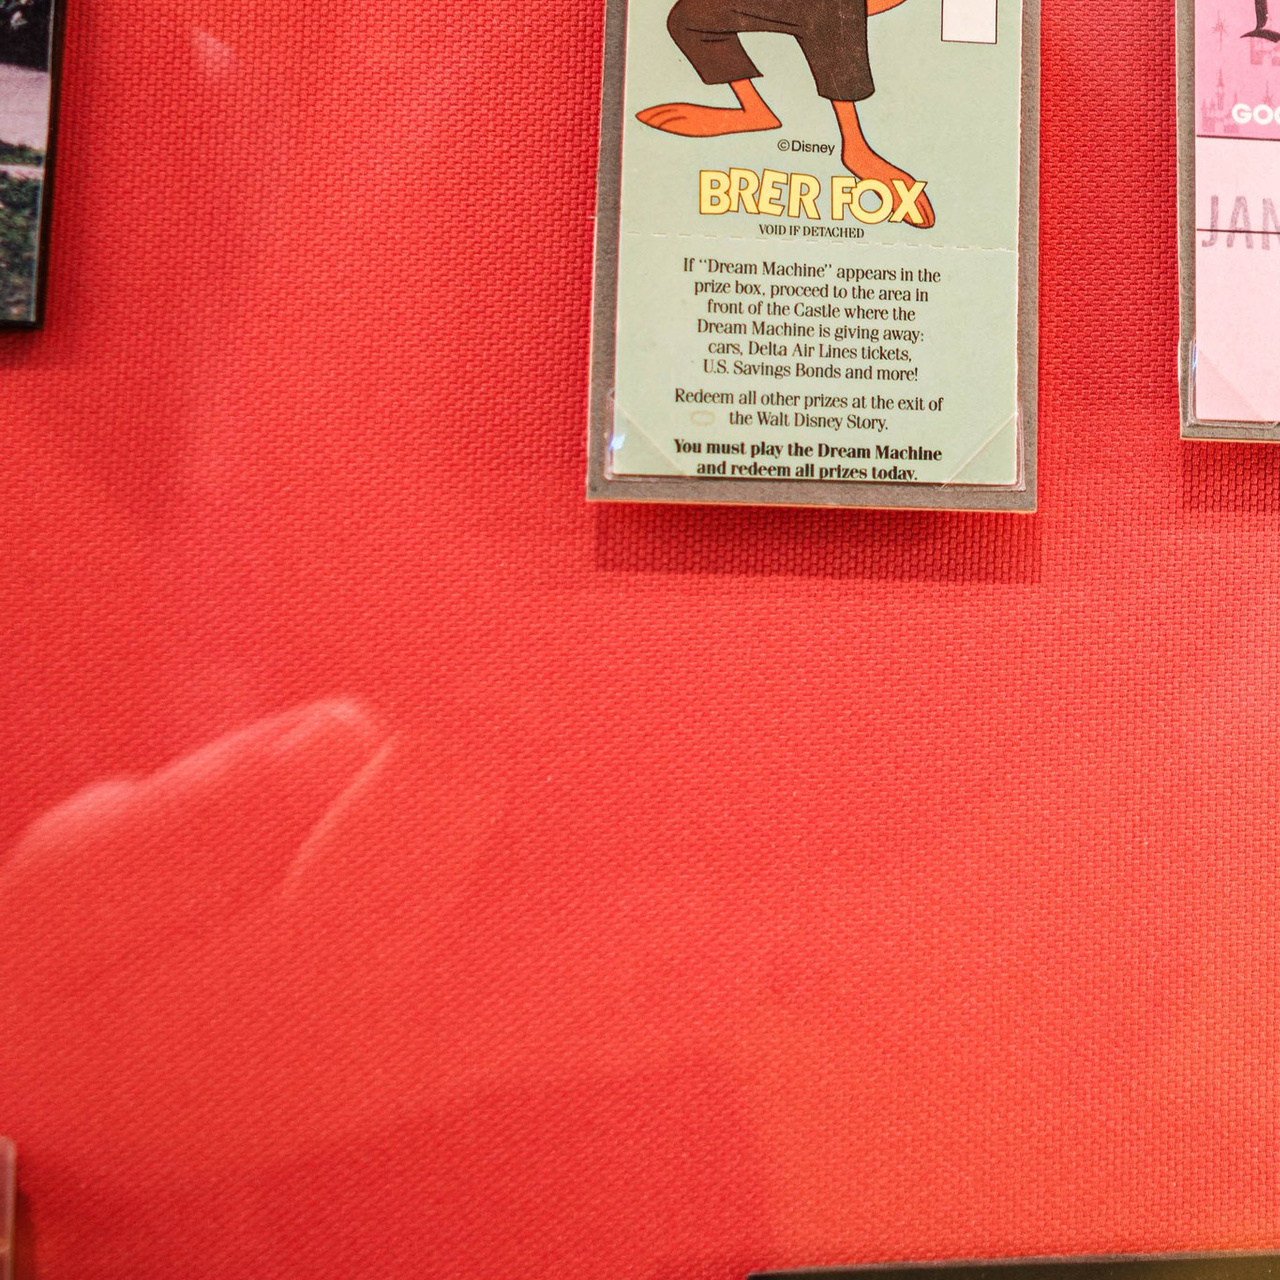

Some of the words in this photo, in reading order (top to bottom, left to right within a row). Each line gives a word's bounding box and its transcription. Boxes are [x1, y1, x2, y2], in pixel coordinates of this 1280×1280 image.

[699, 168, 821, 219] BRER
[831, 176, 928, 224] FOX
[759, 224, 786, 235] VOID
[790, 225, 800, 235] IF
[803, 226, 864, 238] DETACHED
[684, 258, 695, 271] If
[837, 265, 896, 282] appears
[901, 268, 913, 282] in
[918, 270, 941, 283] the
[694, 280, 730, 296] prize
[770, 283, 828, 298] proceed
[833, 286, 847, 299] to
[852, 285, 875, 300] the
[879, 289, 911, 301] area
[915, 288, 929, 302] in
[707, 299, 743, 314] front
[748, 301, 763, 315] of
[767, 302, 790, 316] the
[794, 303, 840, 319] Castle
[844, 306, 888, 320] where
[893, 307, 915, 321] the
[697, 319, 747, 335] Dream
[752, 321, 814, 338] Machine
[819, 324, 831, 338] is
[835, 325, 879, 342] giving
[883, 328, 924, 343] away:
[708, 342, 743, 356] cars,
[748, 341, 787, 356] Delta
[792, 343, 815, 357] Air
[819, 344, 857, 359] Lines
[861, 346, 912, 362] tickets,
[703, 359, 730, 374] U.S.
[734, 360, 791, 379] Savings
[796, 363, 841, 379] Bonds
[845, 365, 873, 380] and
[877, 367, 918, 382] more!
[675, 388, 733, 404] Redeem
[739, 390, 756, 405] all
[761, 391, 800, 407] other
[804, 393, 848, 410] prizes
[852, 395, 867, 409] at
[872, 395, 894, 410] the
[898, 396, 925, 411] exit
[929, 397, 944, 411] of
[729, 411, 752, 425] the
[757, 412, 790, 427] Walt
[794, 413, 842, 431] Disney
[847, 415, 888, 432] Story.
[674, 439, 701, 453] You
[706, 441, 747, 455] must
[751, 442, 783, 459] play
[788, 443, 813, 457] the
[818, 443, 871, 459] Dream
[875, 445, 942, 461] Machine
[697, 461, 726, 475] and
[731, 462, 791, 477] redeem
[795, 463, 814, 477] all
[819, 465, 867, 479] prizes
[872, 466, 917, 481] today.
